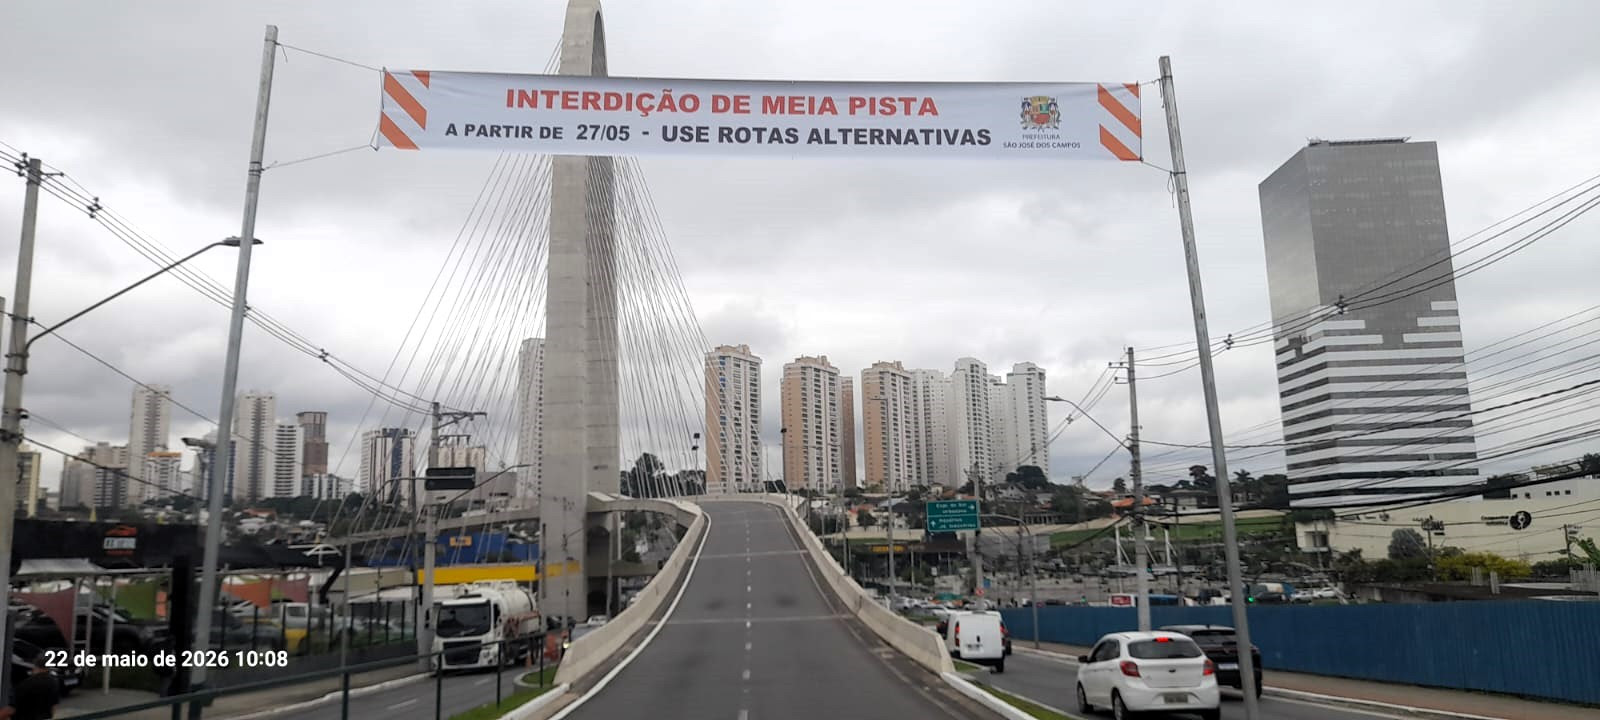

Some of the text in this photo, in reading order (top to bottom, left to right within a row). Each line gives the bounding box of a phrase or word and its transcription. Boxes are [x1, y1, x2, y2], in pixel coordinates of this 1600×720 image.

[506, 88, 939, 117] INTERDIÇÃO DE MEIA PISTA
[445, 123, 458, 137] A
[464, 124, 533, 139] PARTIR
[539, 126, 563, 140] DE
[576, 124, 630, 142] 27/05
[662, 125, 709, 143] USE
[718, 126, 799, 144] ROTAS
[807, 128, 992, 146] ALTERNATIVAS
[1018, 141, 1035, 149] JOSÉ
